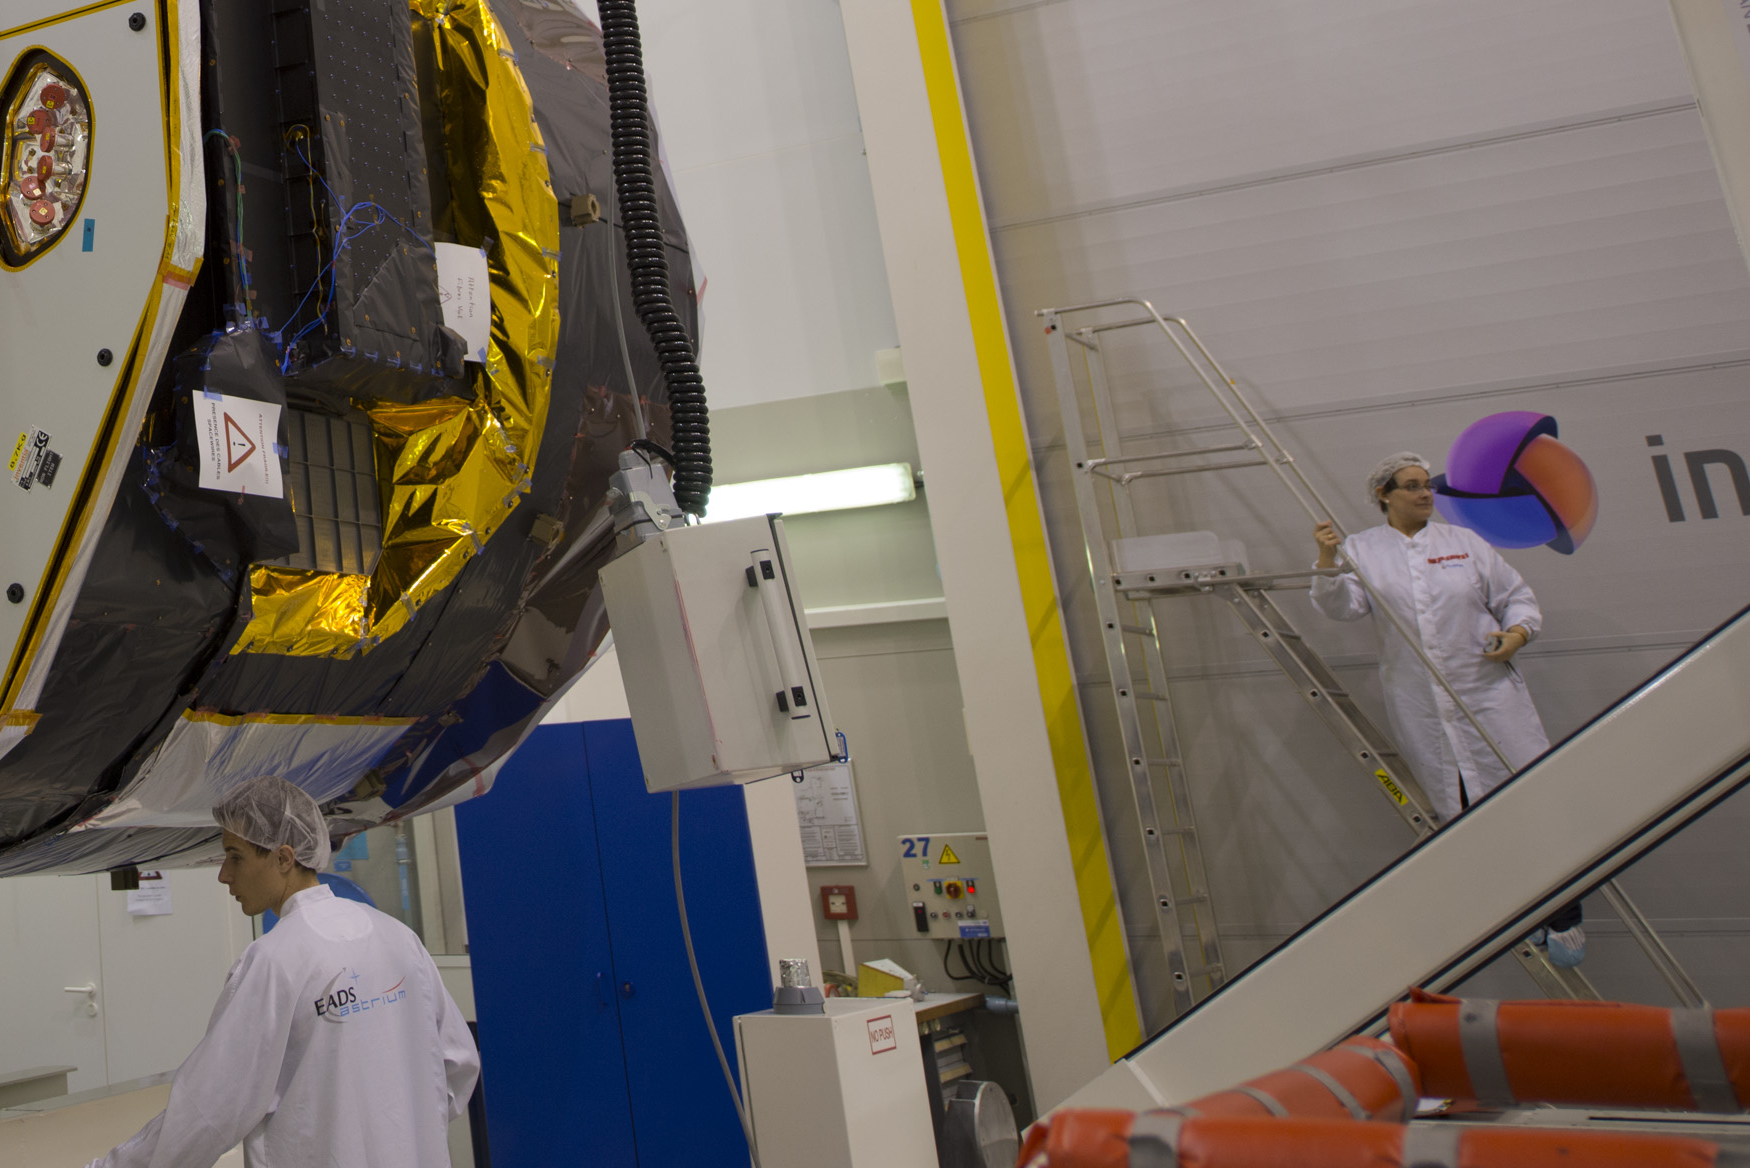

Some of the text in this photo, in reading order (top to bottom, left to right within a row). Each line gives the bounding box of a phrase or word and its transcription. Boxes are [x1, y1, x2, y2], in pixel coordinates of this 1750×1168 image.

[211, 402, 219, 437] PRESENCE
[207, 418, 215, 462] SPACEWIRES
[900, 836, 930, 858] 27
[314, 986, 357, 1017] EADS
[340, 990, 406, 1017] astrium
[870, 1026, 894, 1042] NO PUSH
